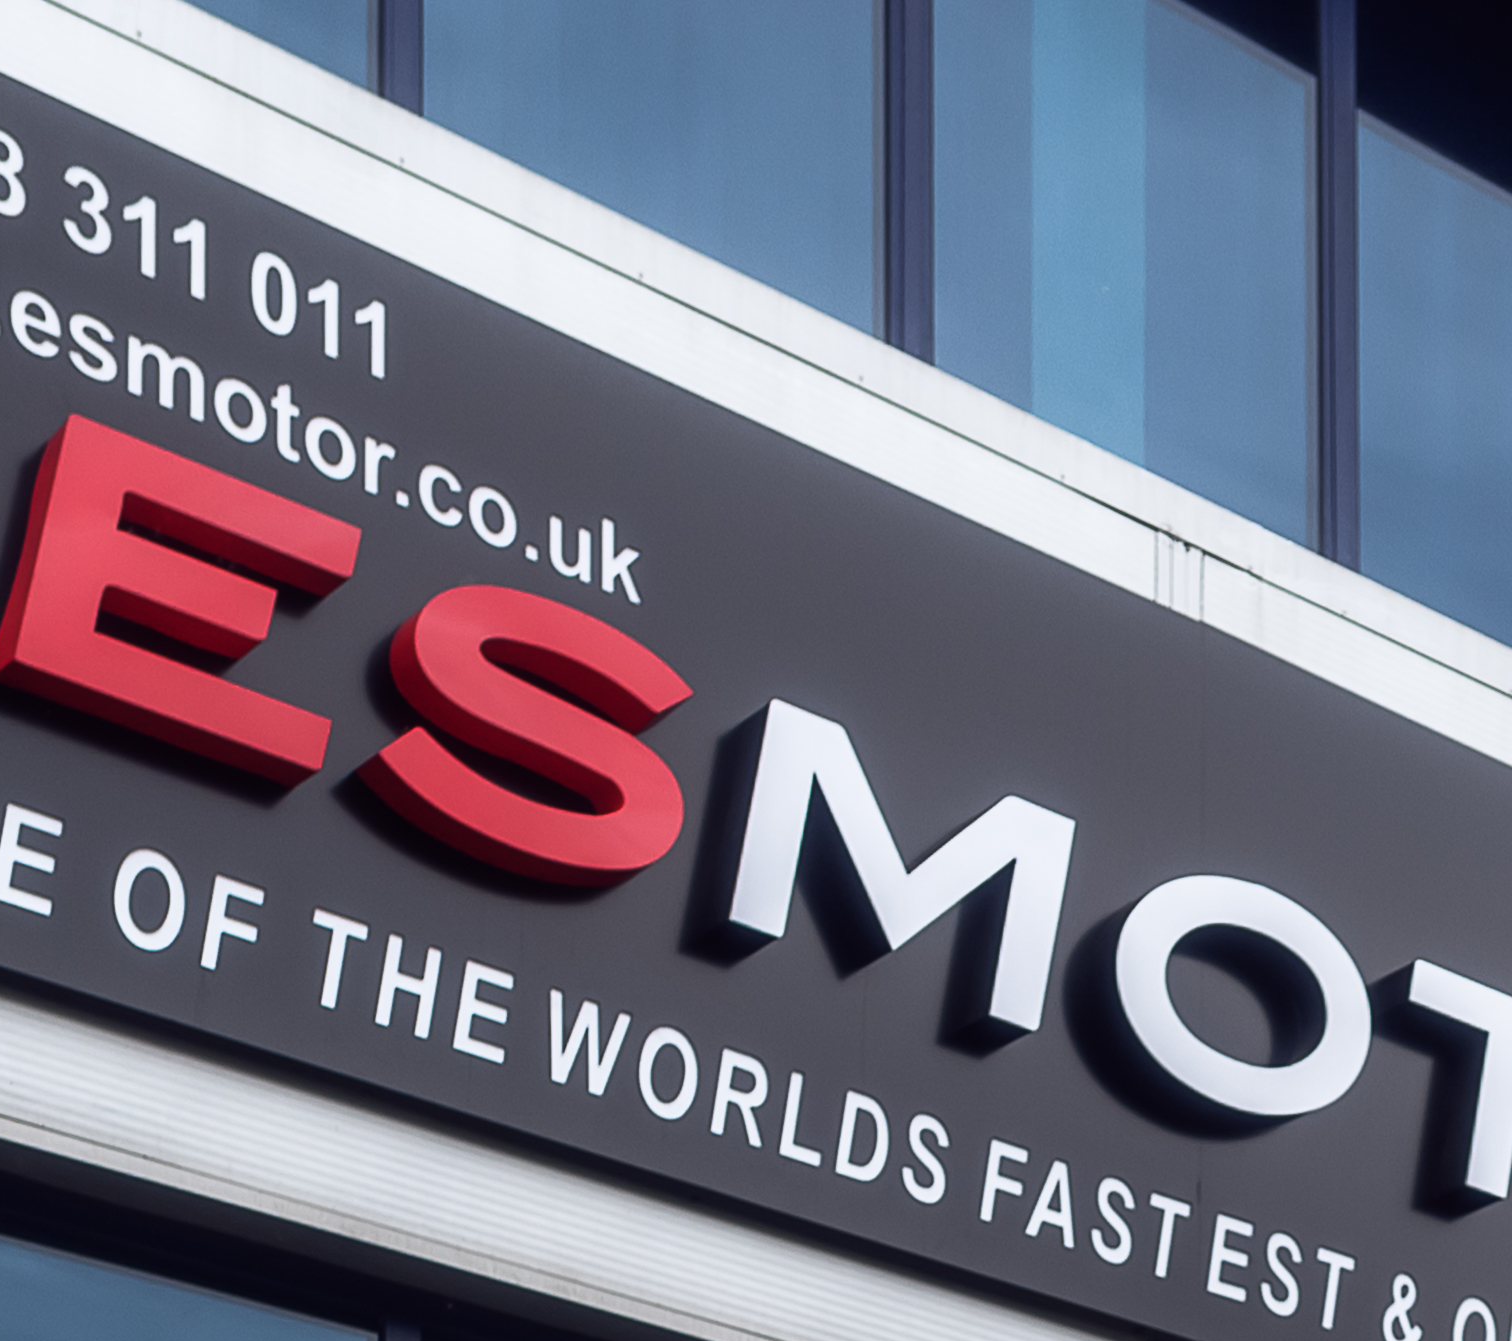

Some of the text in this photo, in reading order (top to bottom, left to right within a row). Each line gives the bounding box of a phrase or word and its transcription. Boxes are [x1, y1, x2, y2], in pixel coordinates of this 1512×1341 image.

[63, 166, 206, 300] 311
[251, 252, 385, 379] 011
[113, 849, 265, 970] OF
[313, 909, 514, 1064] THE
[549, 989, 949, 1204] WORLDS
[980, 1139, 1355, 1330] FASTEST
